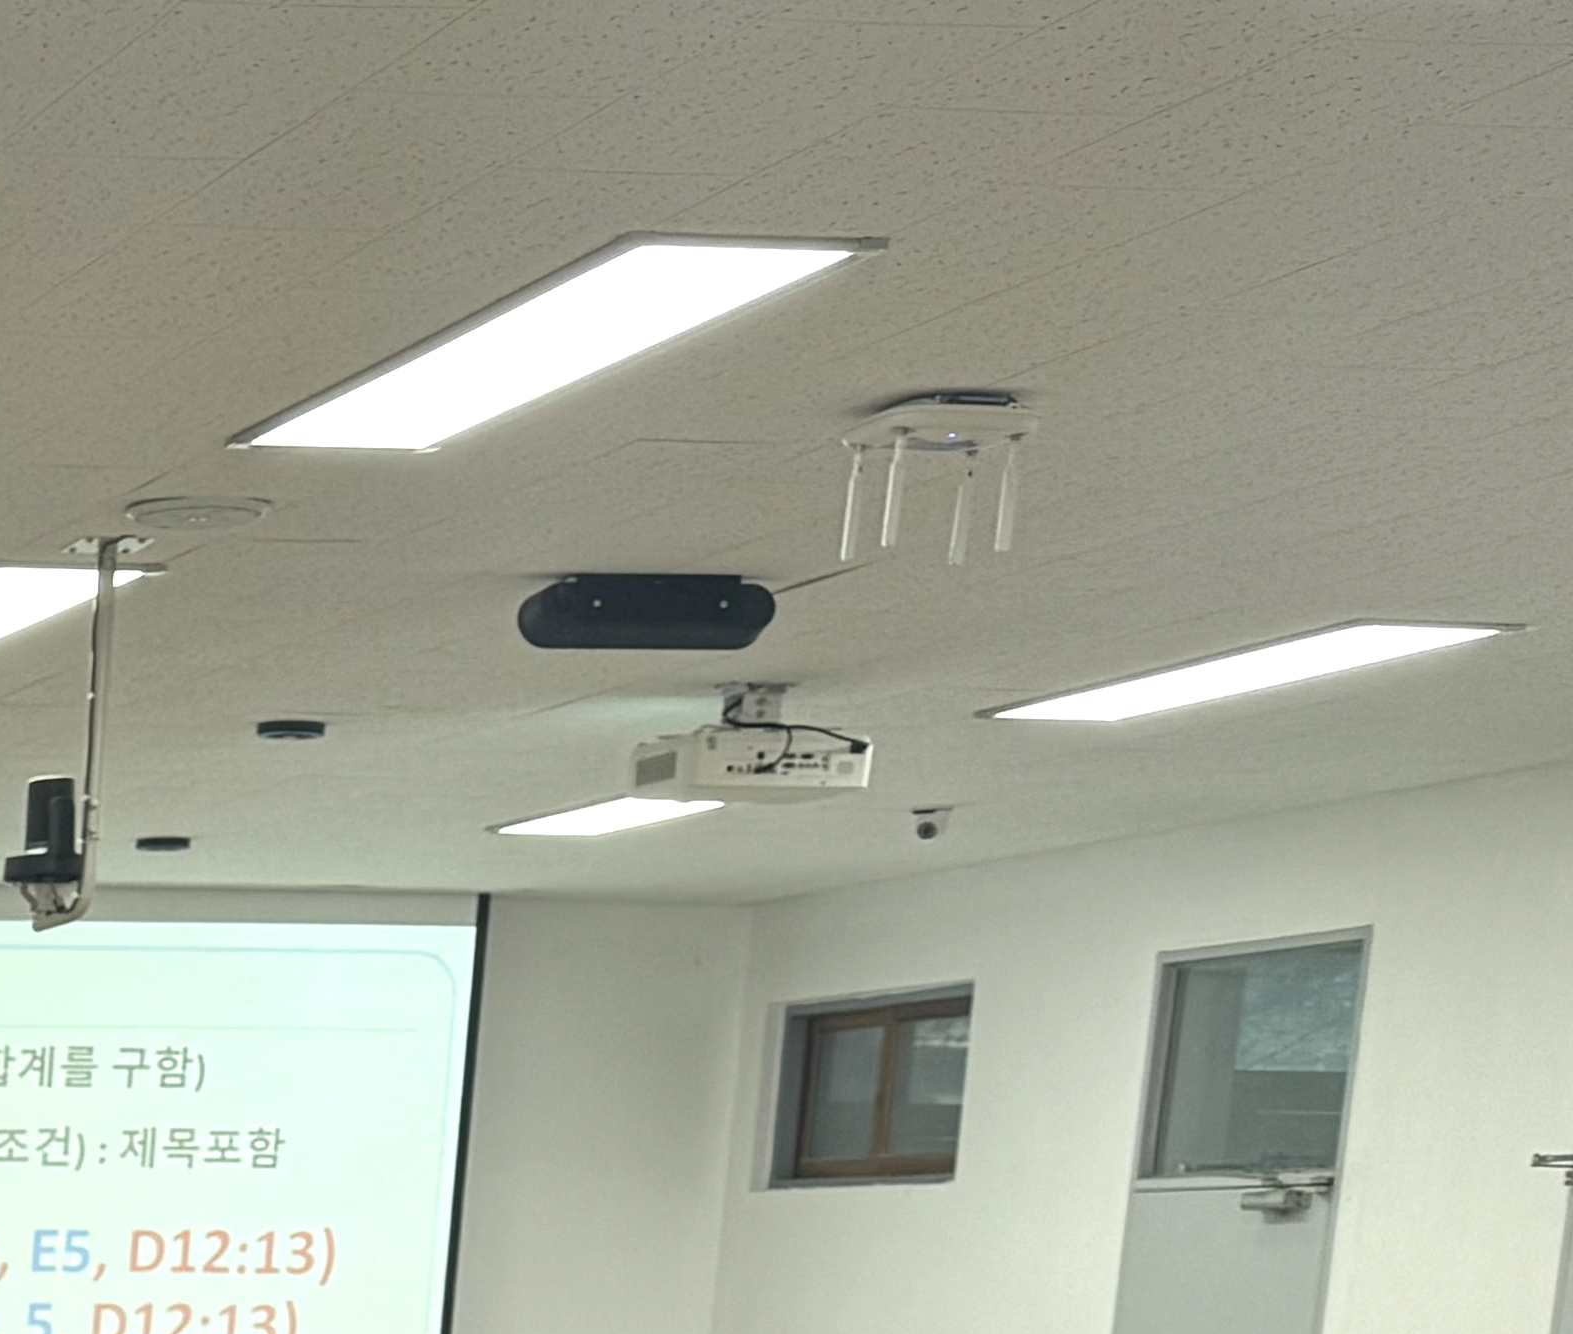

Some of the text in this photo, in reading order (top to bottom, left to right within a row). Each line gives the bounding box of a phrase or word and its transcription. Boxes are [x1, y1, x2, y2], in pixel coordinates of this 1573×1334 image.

[112, 1047, 206, 1093] 구함)
[120, 1127, 286, 1171] 제목포함
[29, 1227, 107, 1284] E5,
[128, 1227, 336, 1285] D12:13)
